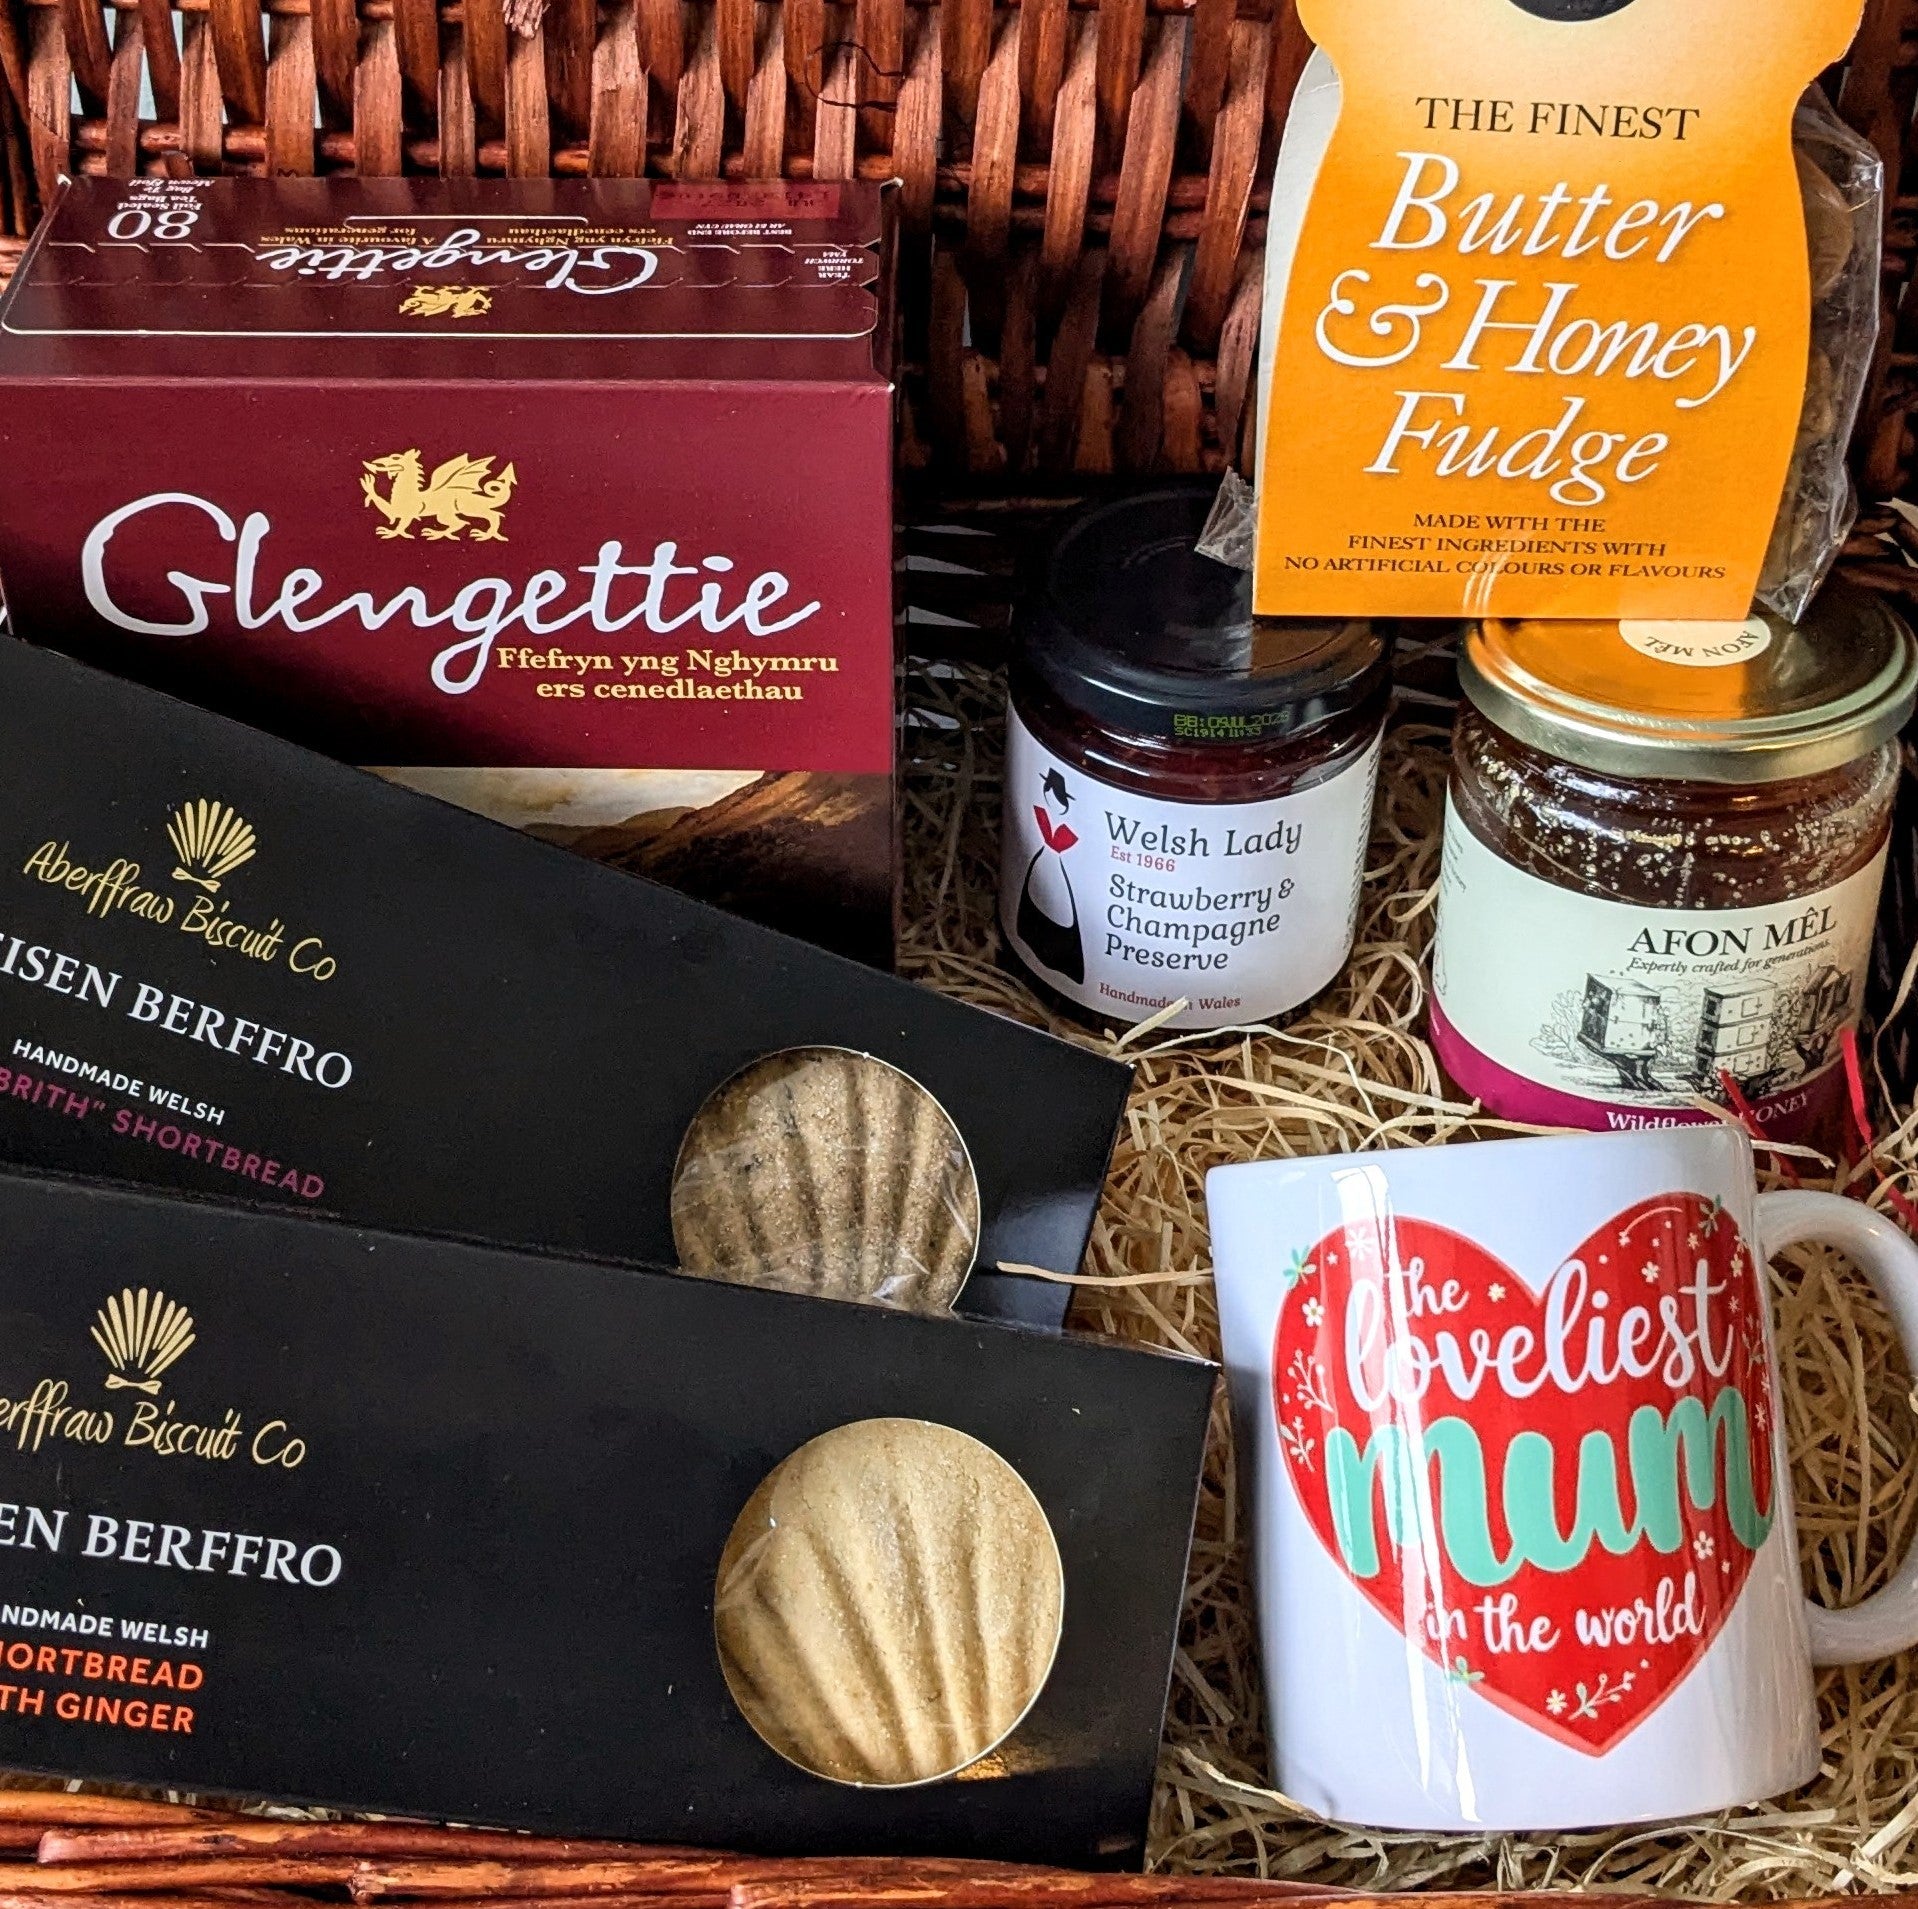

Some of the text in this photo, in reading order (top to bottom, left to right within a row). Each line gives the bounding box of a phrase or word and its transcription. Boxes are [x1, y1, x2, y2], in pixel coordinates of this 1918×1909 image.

[1415, 96, 1700, 141] THE FINEST
[117, 203, 204, 211] Foil Sealed
[129, 194, 167, 203] Bags
[1369, 150, 1725, 264] Butter
[108, 210, 199, 240] 80
[260, 236, 436, 246] A favourite in Wales
[284, 226, 417, 236] for generations
[485, 235, 674, 246] Ffefryn yng Nghymru
[508, 227, 657, 236] ers cenedlaethau
[255, 228, 658, 295] Glengettie
[1315, 269, 1756, 409] & Honey
[1363, 390, 1669, 507] Fudge
[1413, 513, 1605, 533] MADE WITH THE
[1348, 534, 1666, 558] FINEST INGREDIENTS WITH
[1284, 555, 1726, 580] NO ARTIFICIAL COLOURS OR FLAVOURS
[81, 492, 821, 694] Glengettie
[497, 647, 839, 677] Ffefryn yng Nghymru
[1702, 630, 1759, 658] AFON
[536, 678, 804, 700] ers cenedlaethau
[1104, 811, 1302, 857] Welsh Lady
[1110, 846, 1176, 872] Est 1966
[23, 841, 336, 981] Aberffraw Biscuit Co
[1109, 873, 1295, 911] Strawberry &
[1107, 904, 1280, 947] Champagne
[1627, 906, 1837, 957] AFON MÊL
[1105, 933, 1229, 970] Preserve
[1626, 957, 1688, 975] Expertly
[1692, 958, 1740, 975] crafted
[1740, 957, 1761, 974] for
[0, 934, 354, 1089] ISEN BERFFRO
[1099, 982, 1173, 1009] Handmade
[1199, 996, 1241, 1010] Wales
[12, 1039, 225, 1126] HANDMADE WELSH
[113, 1108, 325, 1199] SHORTBREAD
[1385, 1255, 1469, 1319] the
[1344, 1258, 1734, 1414] loveliest
[125, 1400, 243, 1460] Biscuit
[252, 1420, 306, 1468] Co
[1325, 1386, 1775, 1587] mum
[81, 1515, 342, 1587] BERFFRO
[1424, 1570, 1706, 1654] in the world
[120, 1618, 209, 1649] WELSH
[0, 1640, 203, 1691] ORTBREAD
[56, 1691, 195, 1733] GINGER
